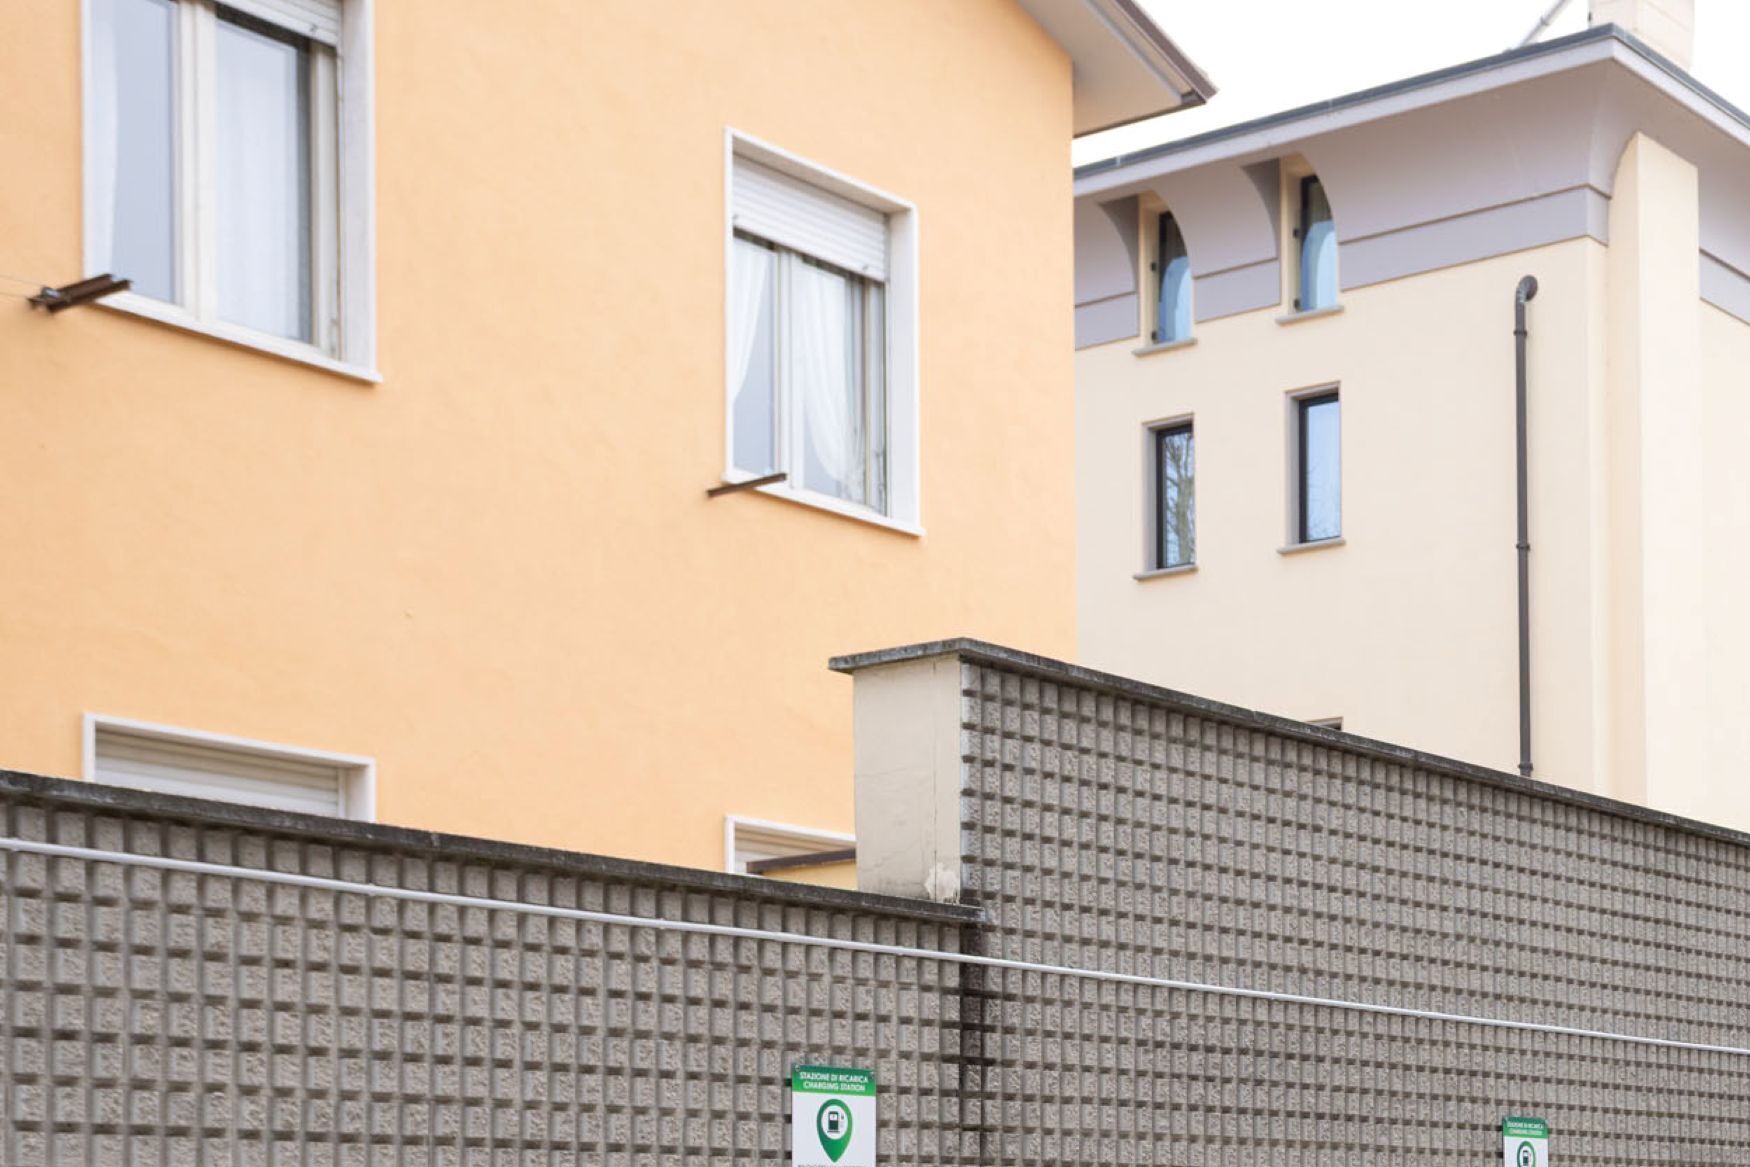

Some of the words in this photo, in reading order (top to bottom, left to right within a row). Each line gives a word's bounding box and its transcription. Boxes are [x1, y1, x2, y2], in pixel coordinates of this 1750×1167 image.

[799, 1072, 828, 1080] STAZIONE
[839, 1074, 868, 1083] RICARICA
[803, 1081, 838, 1090] CHARGING
